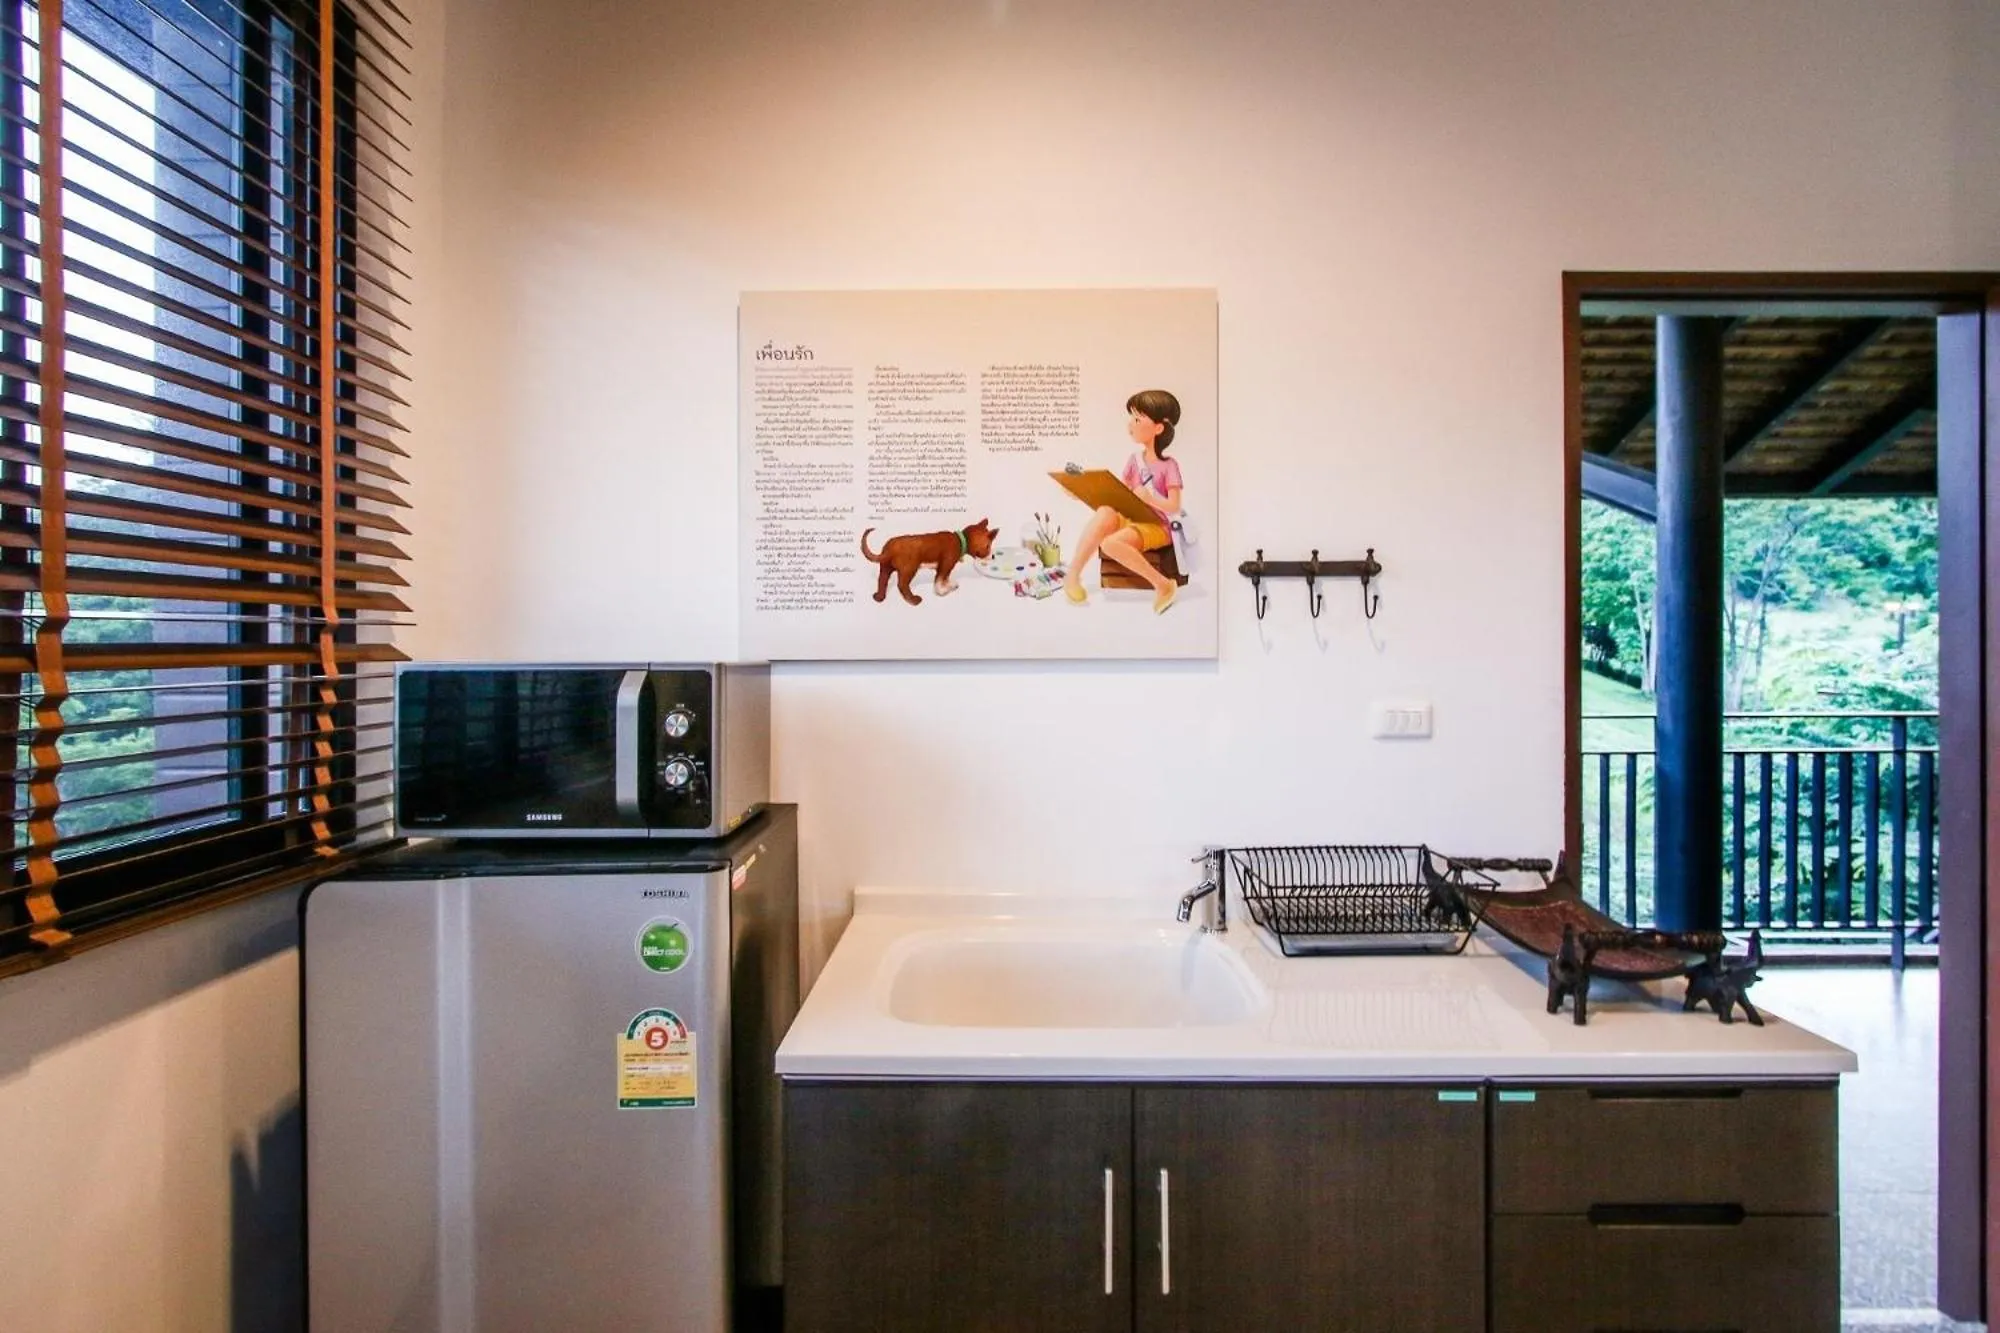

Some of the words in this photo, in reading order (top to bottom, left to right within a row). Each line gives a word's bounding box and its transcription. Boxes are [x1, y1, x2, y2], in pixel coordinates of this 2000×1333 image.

[756, 339, 814, 361] เพื่อนรัก
[526, 813, 562, 821] SAMSUNG
[650, 1031, 664, 1047] 5
